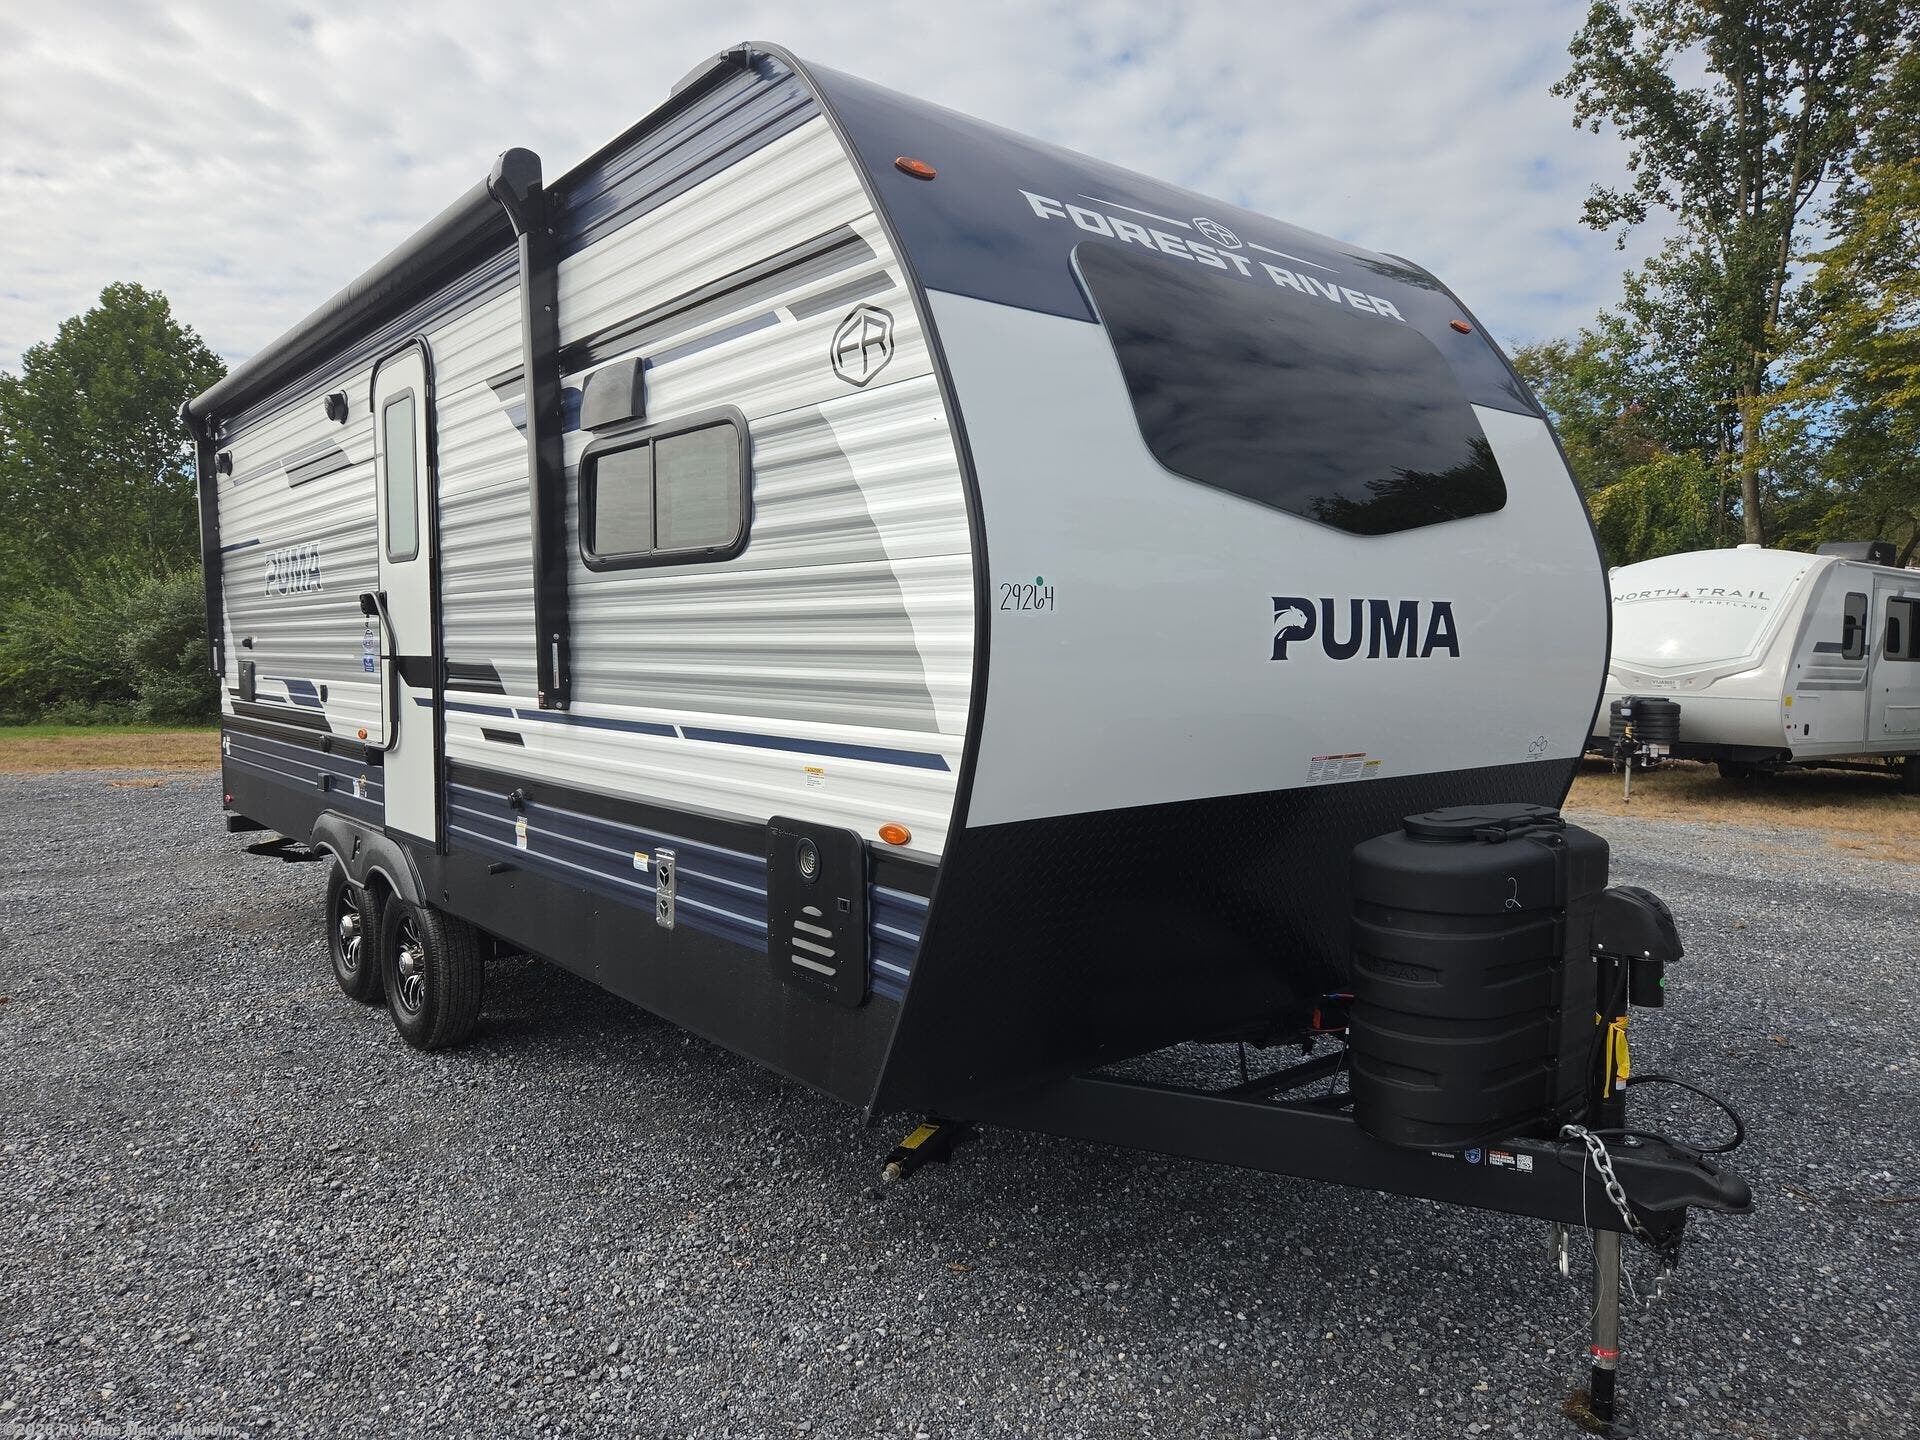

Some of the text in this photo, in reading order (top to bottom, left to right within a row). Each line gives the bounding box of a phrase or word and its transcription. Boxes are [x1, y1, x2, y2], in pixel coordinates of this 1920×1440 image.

[1018, 189, 1407, 322] FOREST RIVER
[266, 543, 322, 596] PUMA
[1000, 583, 1054, 611] 29264
[1613, 588, 1770, 603] NORTH TRAIL
[1690, 600, 1768, 611] HEARTLAND
[1270, 596, 1460, 660] PUMA
[1505, 877, 1523, 909] 2
